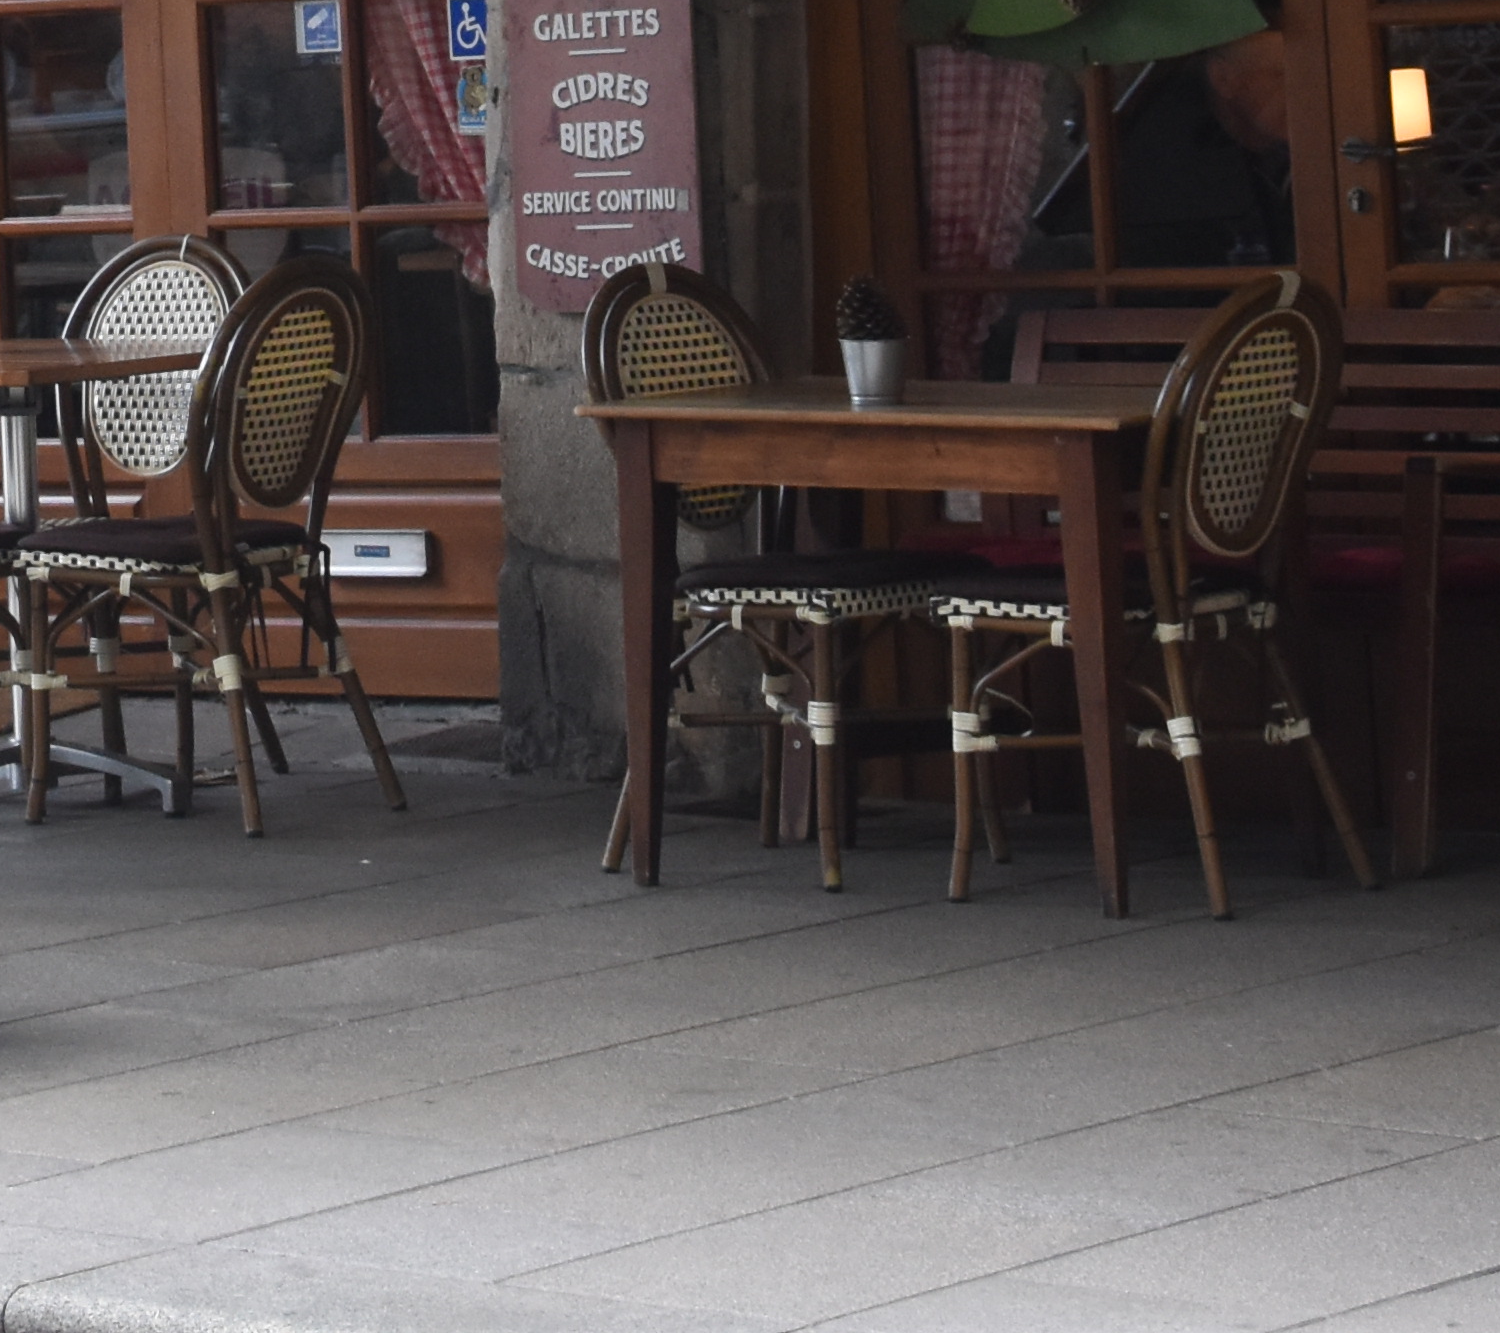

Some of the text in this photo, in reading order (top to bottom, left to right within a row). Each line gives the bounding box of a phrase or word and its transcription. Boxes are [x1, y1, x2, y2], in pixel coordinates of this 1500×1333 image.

[533, 8, 660, 41] GALETTES
[552, 72, 651, 109] CIDRES
[559, 119, 645, 160] BIERES
[522, 187, 676, 215] SERVICE CONTINU
